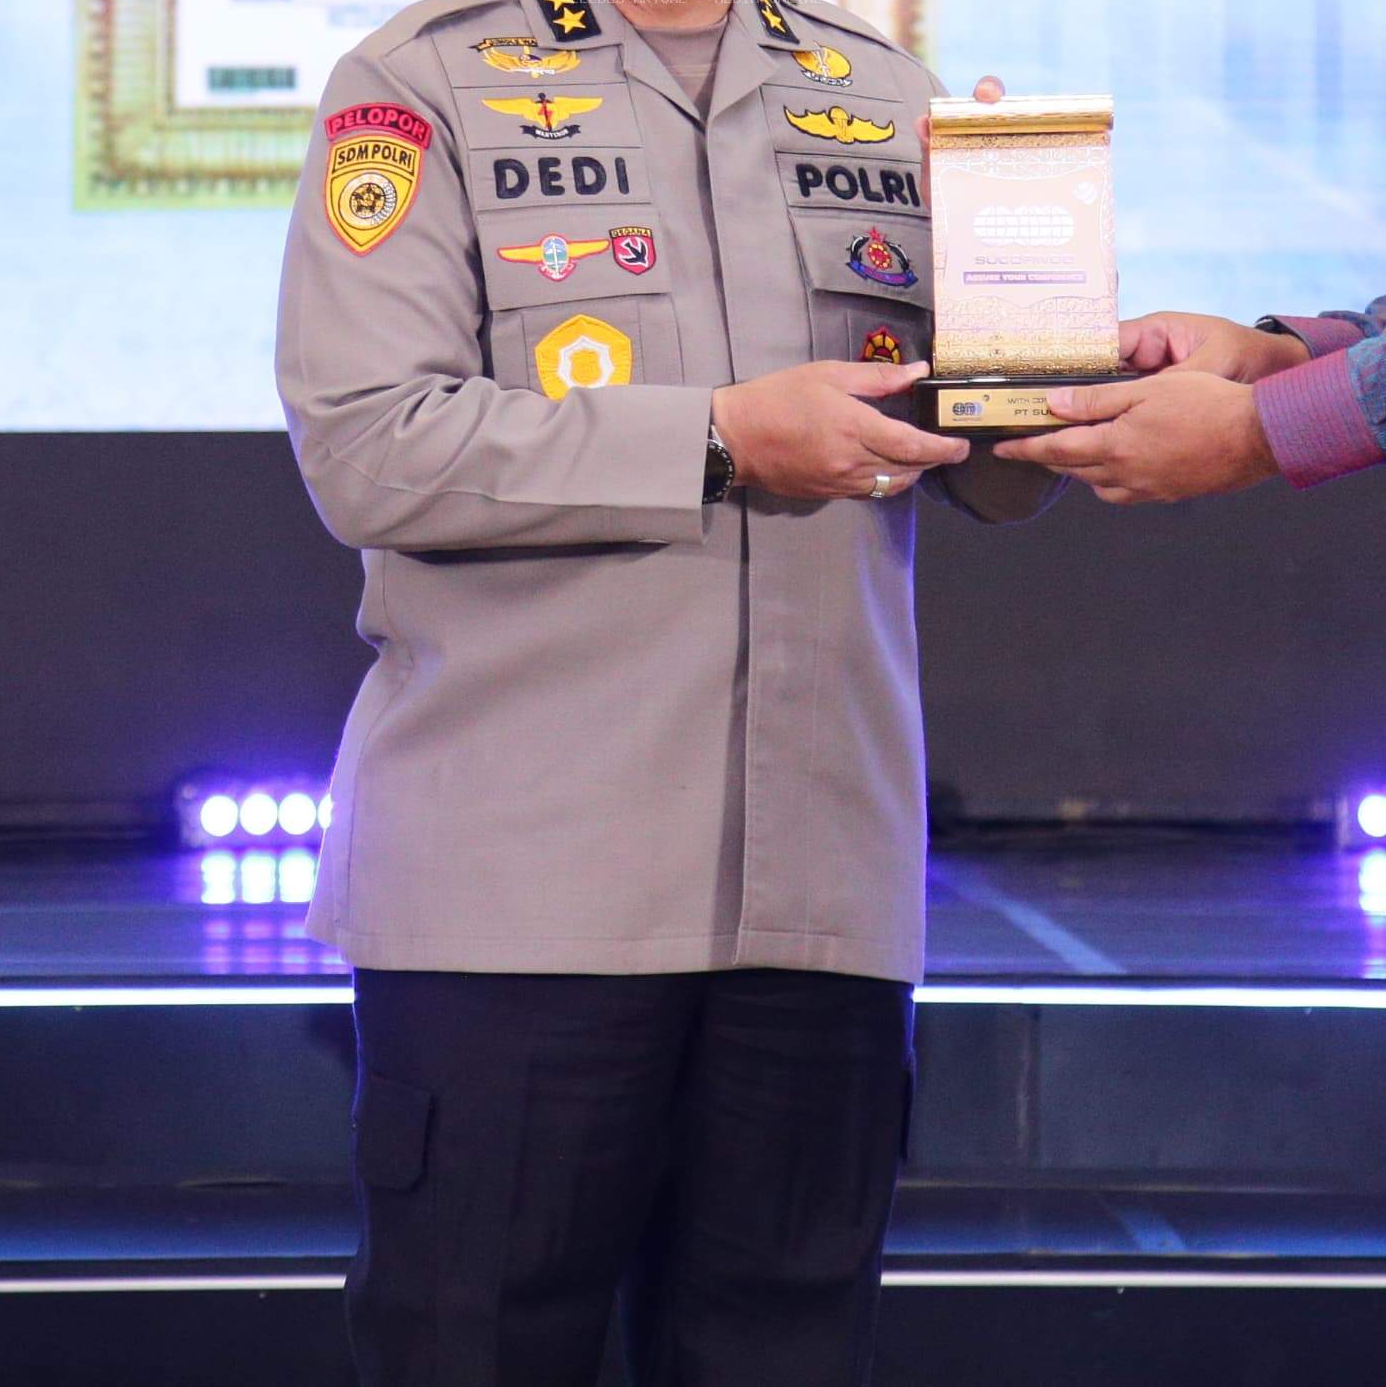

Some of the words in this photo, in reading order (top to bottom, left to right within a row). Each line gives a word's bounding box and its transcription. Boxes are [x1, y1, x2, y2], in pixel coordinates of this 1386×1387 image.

[330, 108, 425, 140] PELOPOR
[337, 144, 369, 165] SDM
[371, 145, 413, 169] POLRI
[493, 156, 630, 199] DEDI
[796, 163, 921, 208] POLRI
